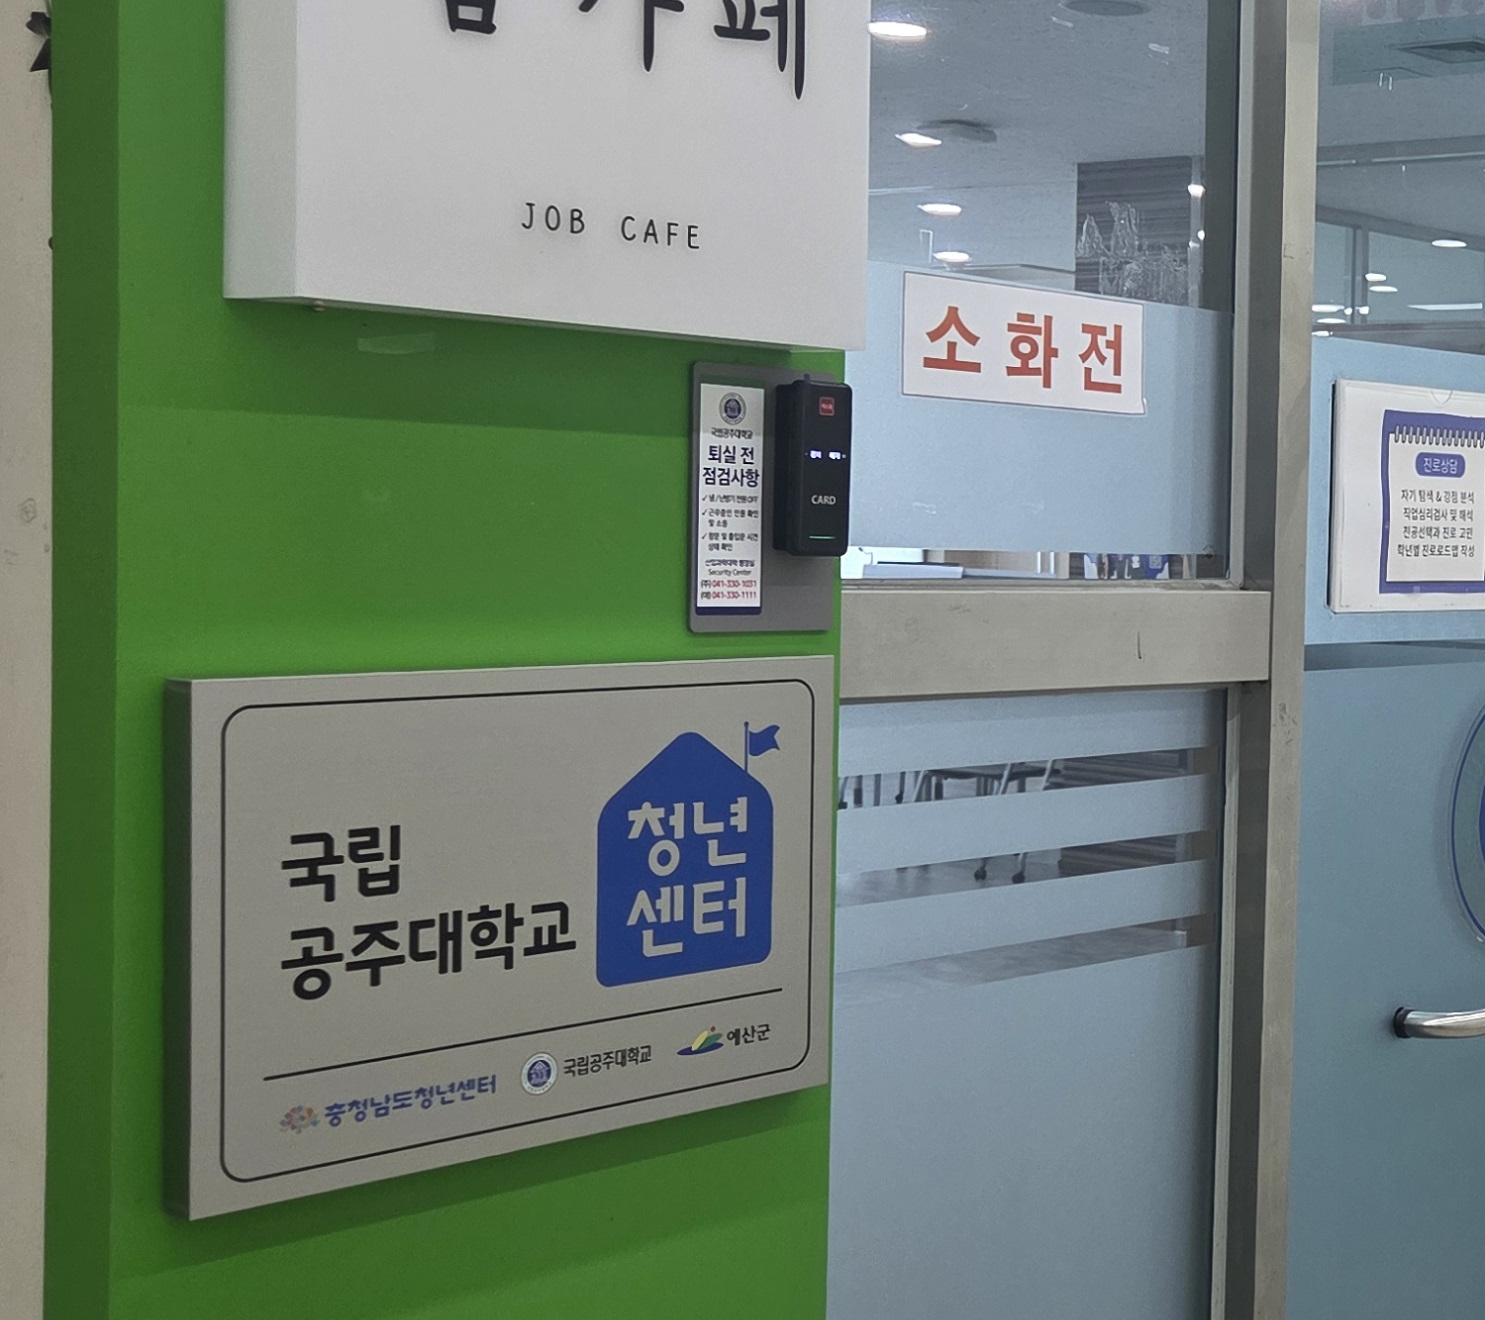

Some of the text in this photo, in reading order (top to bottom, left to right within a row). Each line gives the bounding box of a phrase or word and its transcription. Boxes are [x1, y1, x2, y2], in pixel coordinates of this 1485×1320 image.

[521, 202, 702, 250] JOB CAFE
[708, 445, 755, 465] 퇴실 전
[1423, 457, 1458, 474] 진로상담
[702, 467, 760, 488] 점검사항
[811, 495, 836, 505] CARD
[627, 796, 748, 877] 청년
[281, 824, 401, 902] 국립
[626, 876, 747, 959] 센터
[280, 901, 577, 1001] 공주대학교
[727, 1024, 771, 1048] 예산군
[563, 1044, 653, 1077] 국립공주대학교
[324, 1074, 497, 1127] 충청남도청년센터
